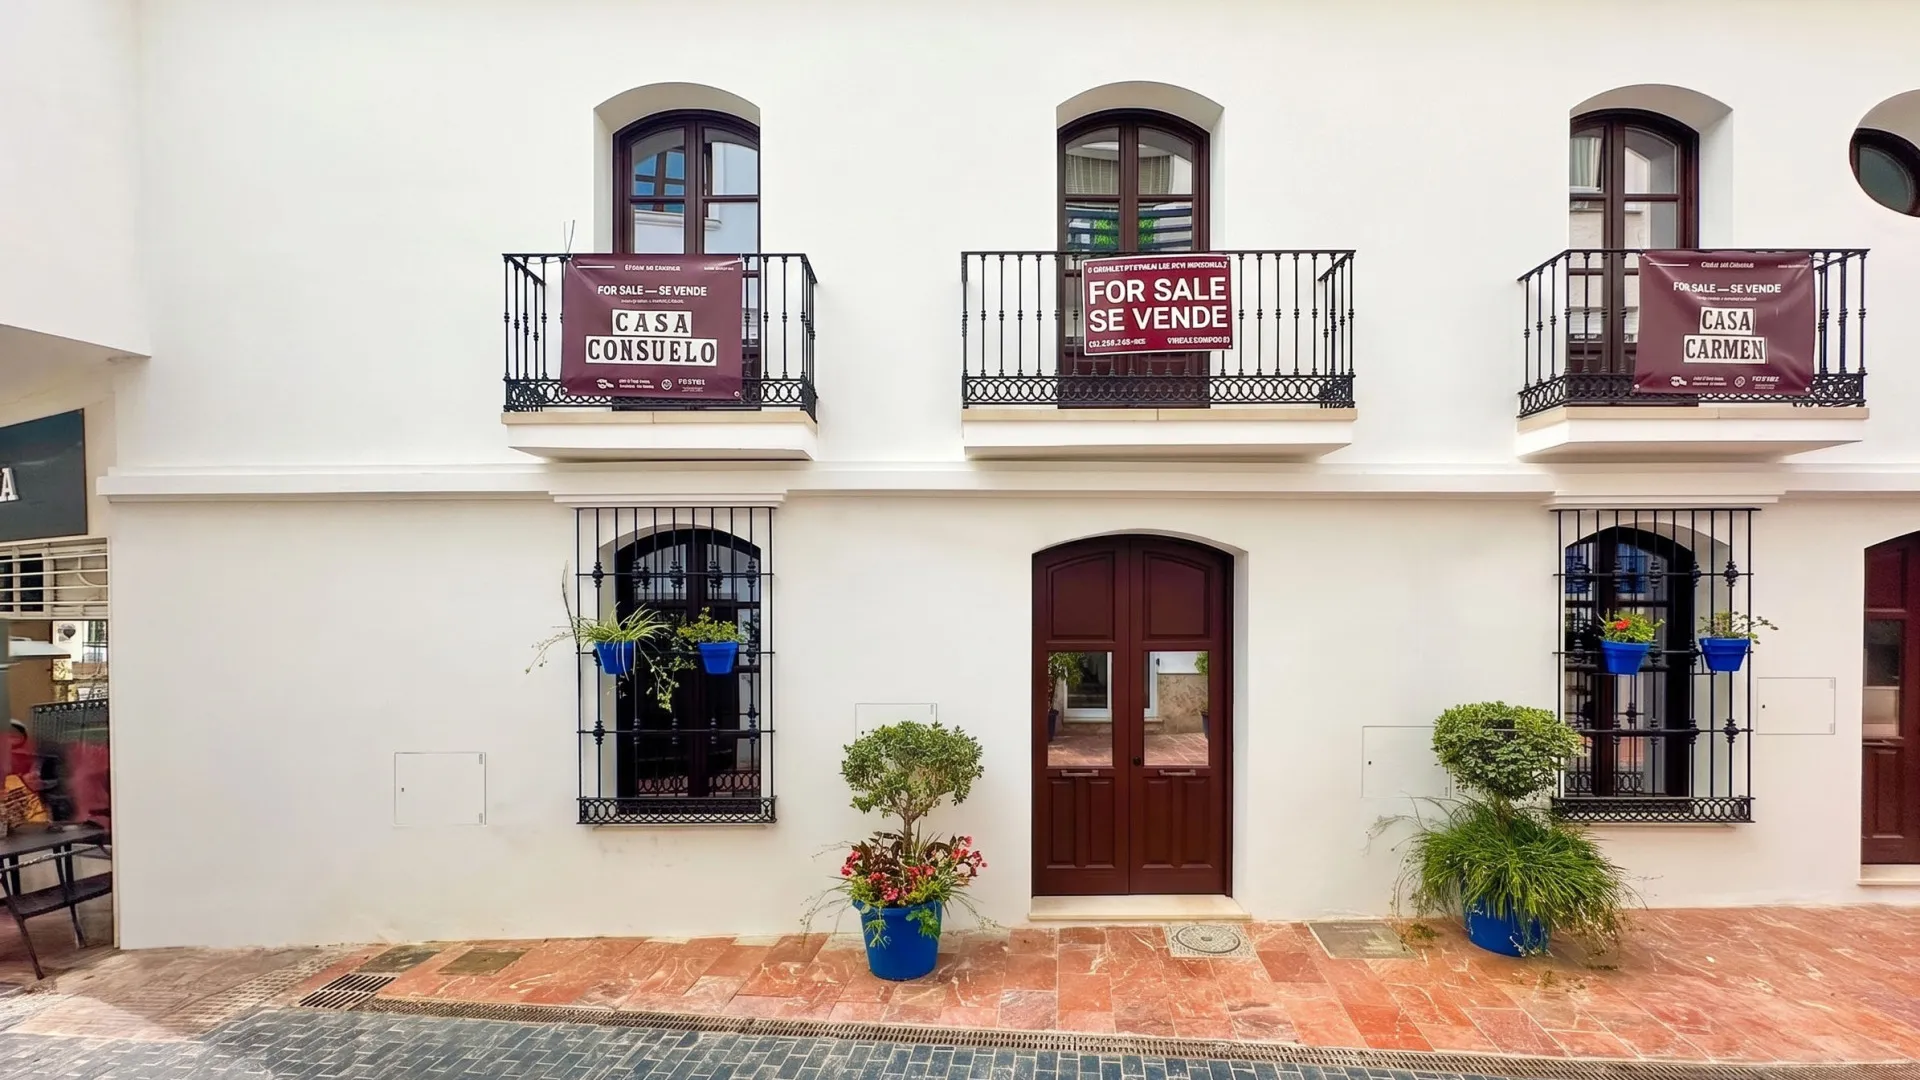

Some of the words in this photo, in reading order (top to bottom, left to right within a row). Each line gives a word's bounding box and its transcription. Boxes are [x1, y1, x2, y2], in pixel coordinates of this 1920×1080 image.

[597, 285, 617, 295] FOR
[619, 285, 644, 295] SALE
[658, 286, 672, 296] SE
[674, 286, 707, 297] VENDE
[1089, 279, 1146, 305] FOR
[1154, 276, 1227, 301] SALE
[1673, 281, 1690, 292] FOR
[1691, 283, 1716, 293] SALE
[1730, 284, 1744, 293] SE
[1746, 284, 1782, 294] VENDE
[615, 312, 689, 334] CASA
[1089, 308, 1125, 332] SE
[1132, 305, 1228, 330] VENDE
[1702, 309, 1752, 331] CASA
[587, 338, 716, 363] CONSUELO
[1685, 338, 1764, 360] CARMEN
